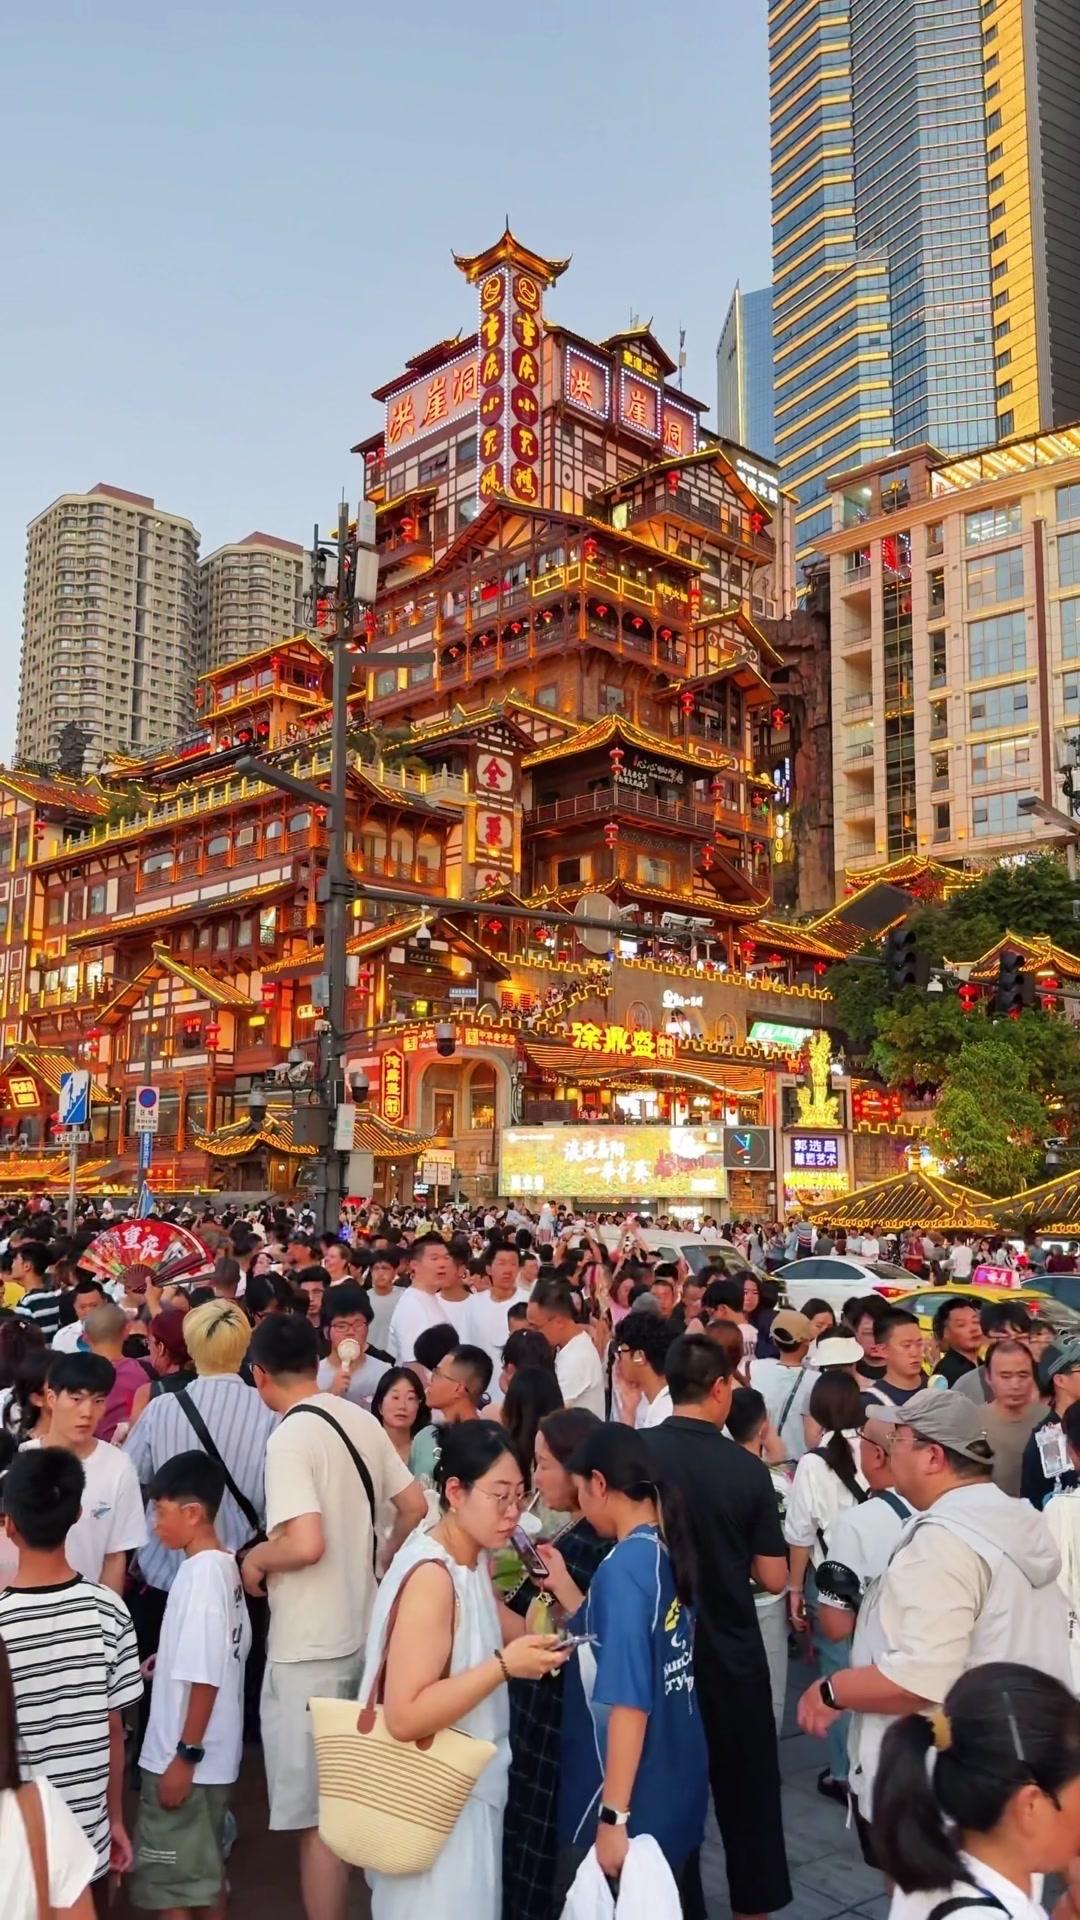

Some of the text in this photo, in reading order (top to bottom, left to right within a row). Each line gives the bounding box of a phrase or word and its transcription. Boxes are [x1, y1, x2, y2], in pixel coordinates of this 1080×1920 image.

[389, 361, 479, 443] 洪崖洞
[517, 312, 538, 498] 重庆小天鹅
[570, 366, 682, 454] 洪崖洞
